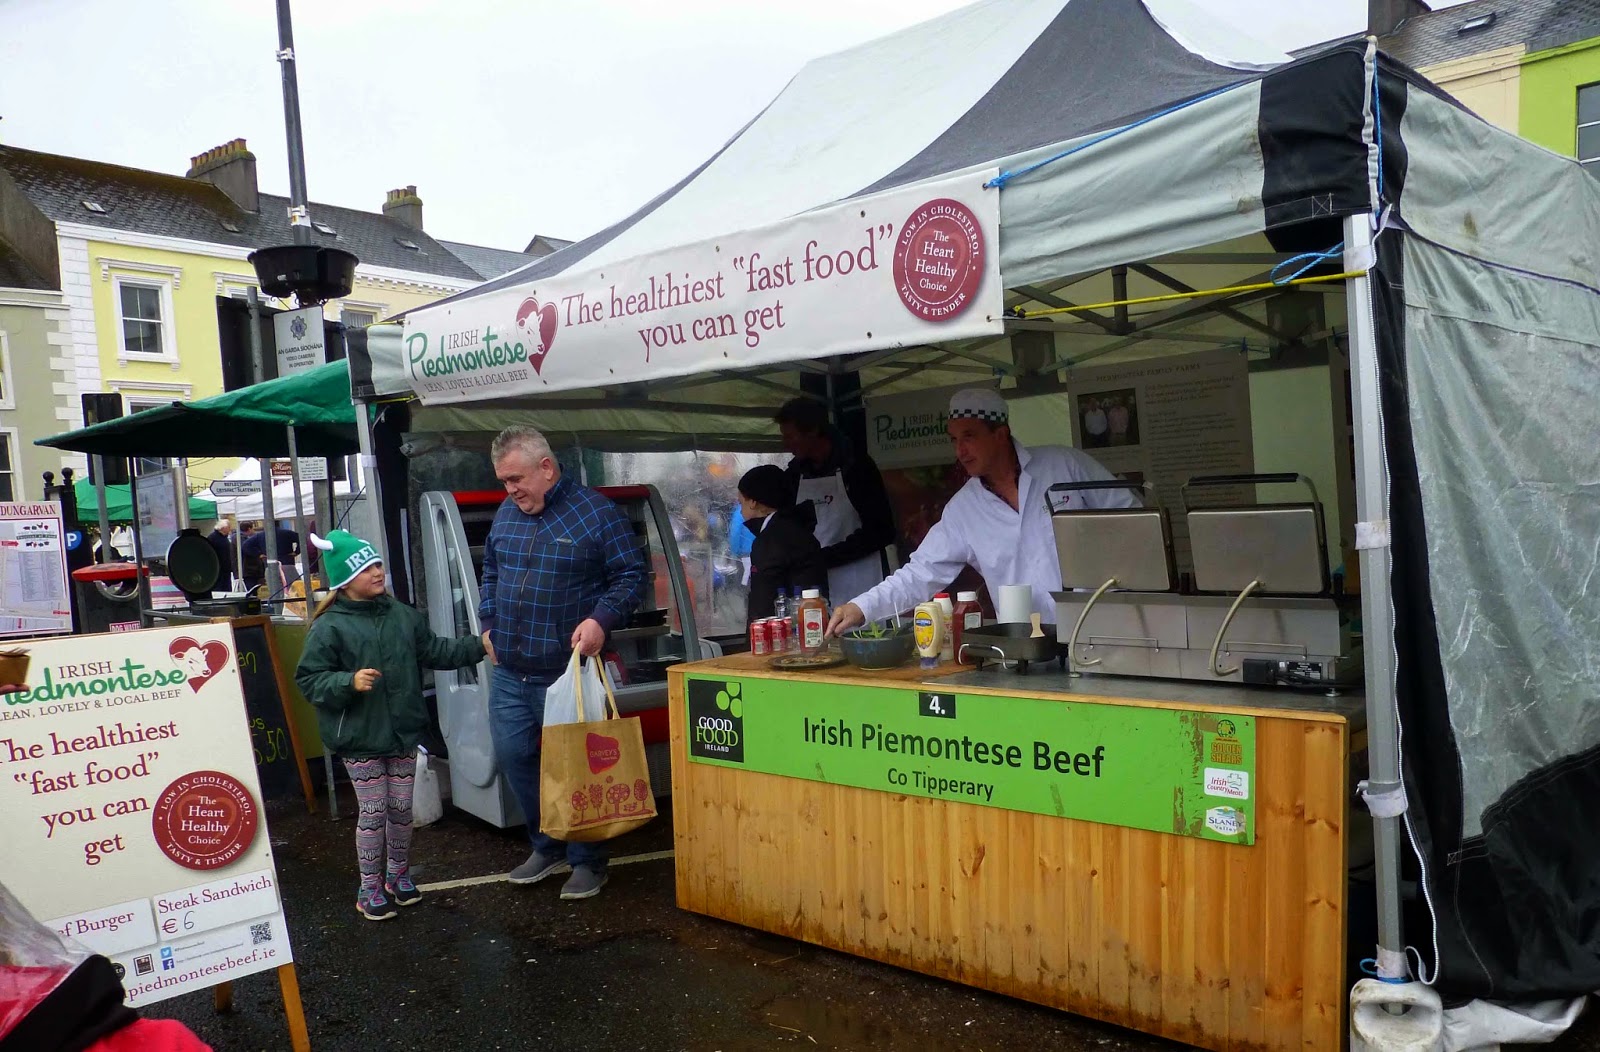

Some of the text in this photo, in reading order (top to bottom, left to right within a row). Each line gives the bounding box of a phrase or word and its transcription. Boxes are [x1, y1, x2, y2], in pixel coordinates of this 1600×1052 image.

[902, 205, 980, 259] LOW IN CHOLESTEROL
[933, 229, 950, 243] The
[923, 241, 955, 259] Heart
[915, 258, 958, 283] Healthy
[919, 277, 948, 292] Choice
[561, 292, 604, 328] The
[609, 271, 726, 319] healthiest
[901, 283, 966, 316] TASTY & TENDER
[448, 329, 479, 350] IRISH
[638, 299, 786, 363] you can get
[405, 325, 528, 382] Piedmontese
[424, 369, 529, 393] LEAN, LOVELY & LOCAL BEEF
[0, 504, 56, 516] DUNGARVAN
[66, 533, 77, 547] P
[58, 660, 113, 679] IRISH
[4, 658, 188, 706] iedmontese
[39, 700, 92, 716] LOVELY
[94, 698, 103, 709] &
[106, 692, 150, 707] LOCAL
[151, 688, 182, 701] BEEF
[928, 695, 947, 716] 4.
[698, 716, 733, 732] GOOD
[48, 720, 180, 757] healthiest
[696, 726, 739, 747] FOOD
[704, 743, 730, 753] IRELAND
[803, 717, 1106, 778] Irish Piemontese Beef
[1211, 741, 1242, 755] GOLDEN
[1211, 752, 1242, 765] SHEARS
[887, 767, 995, 802] Co Tipperary
[1211, 776, 1228, 787] Irish
[161, 776, 252, 817] LOW IN CHOLESTEROL
[198, 795, 218, 806] The
[41, 796, 150, 839] you can
[188, 805, 225, 818] Heart
[1208, 816, 1243, 828] SLANEY
[181, 819, 231, 836] Healthy
[1214, 824, 1237, 833] Valley
[84, 834, 126, 866] get
[188, 834, 221, 845] Choice
[166, 841, 243, 866] TASTY & TENDER
[158, 876, 273, 915] Steak Sandwich
[75, 912, 135, 935] Burger
[126, 948, 276, 1002] piedmontesebeef.ie
